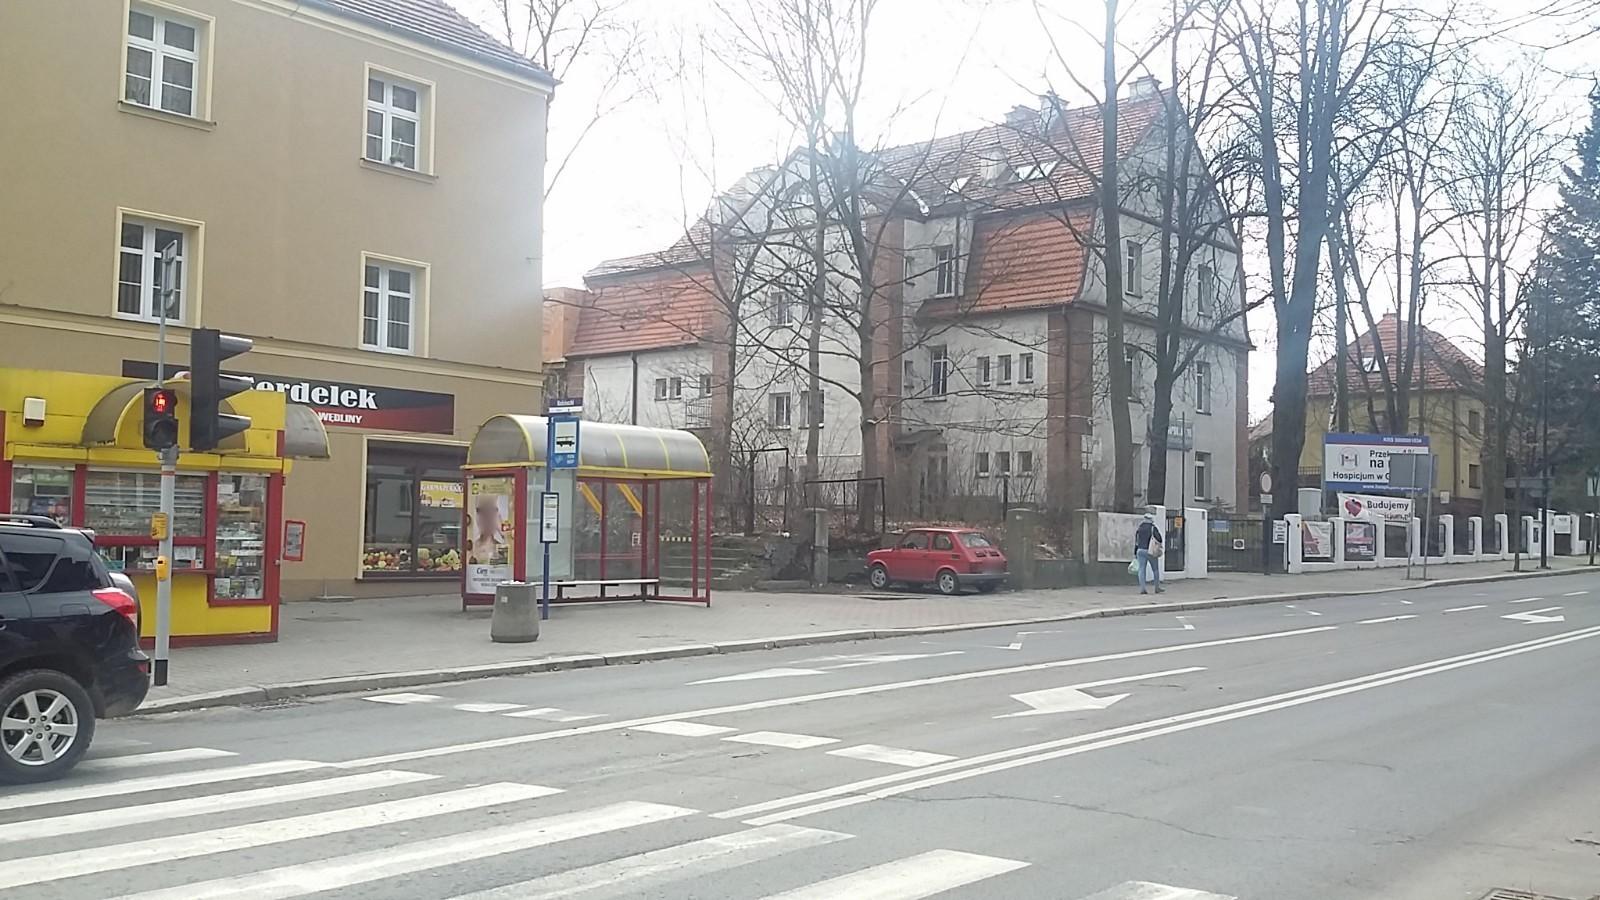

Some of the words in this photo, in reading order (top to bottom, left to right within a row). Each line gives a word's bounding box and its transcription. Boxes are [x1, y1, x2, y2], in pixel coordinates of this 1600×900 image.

[250, 378, 378, 410] erdelek
[318, 411, 363, 424] WĘDLINY
[1369, 459, 1384, 468] na
[1332, 471, 1375, 481] Hospicjum
[1367, 500, 1409, 511] Budujemy
